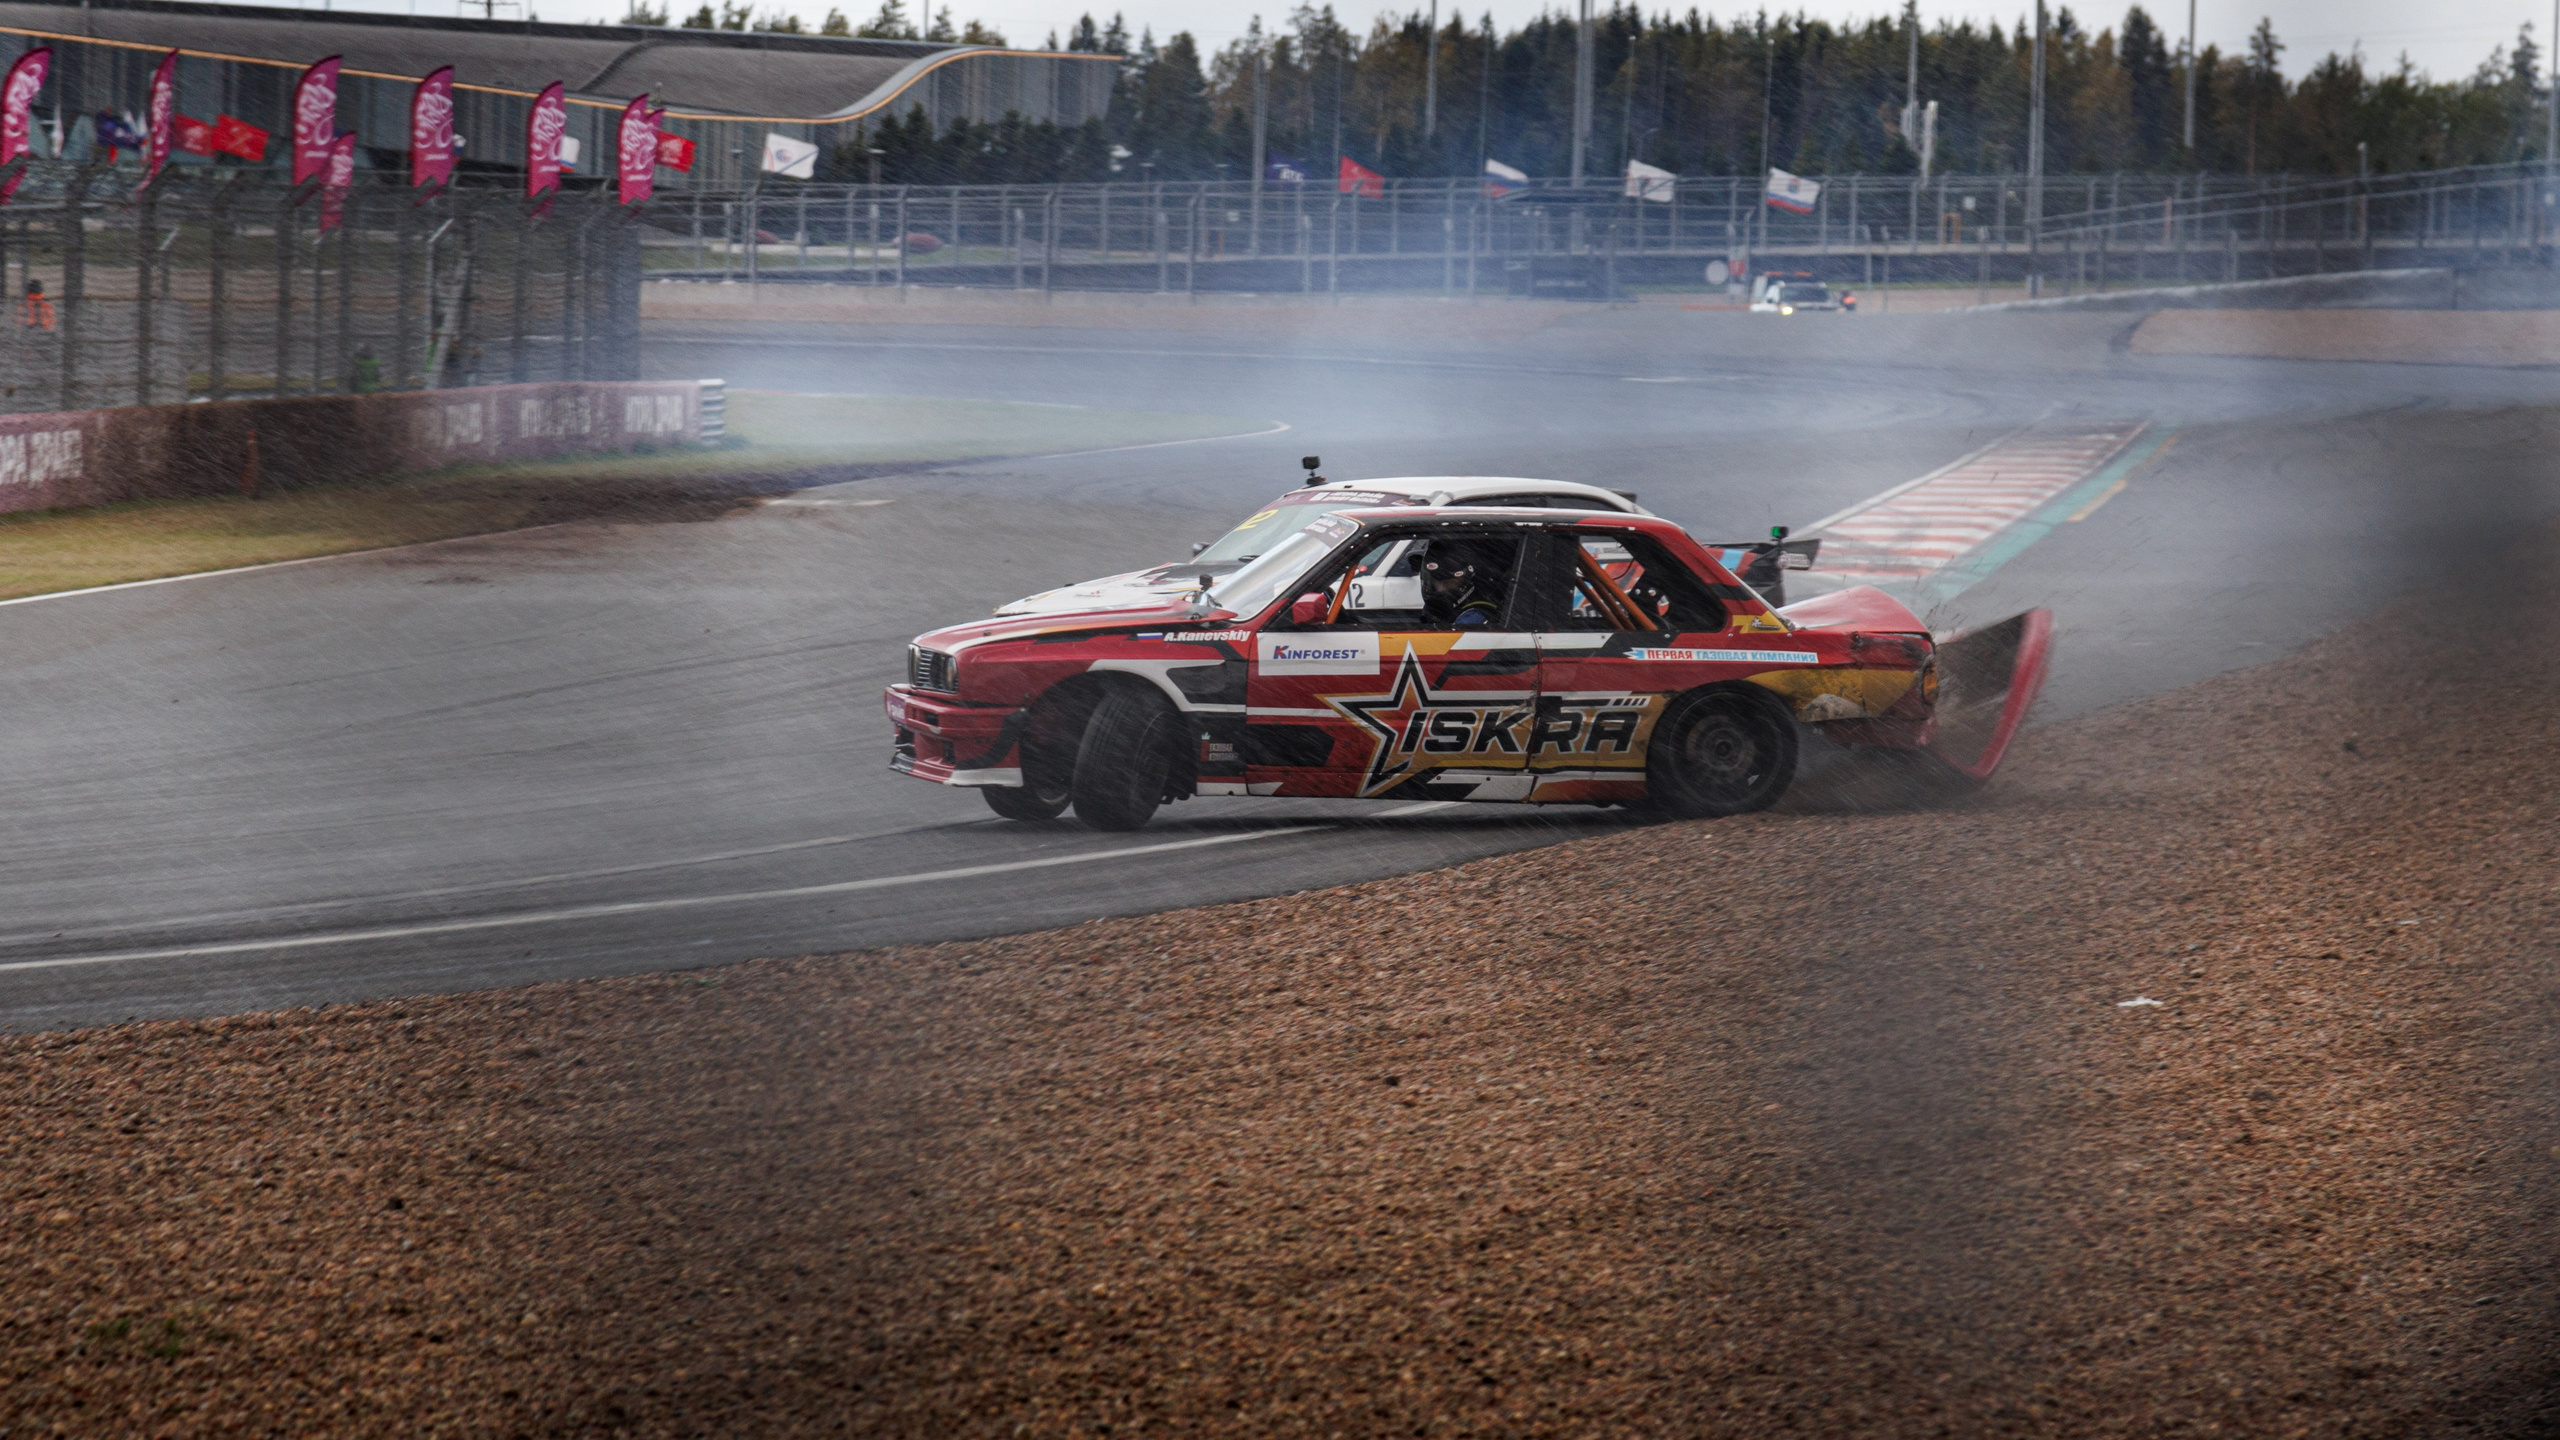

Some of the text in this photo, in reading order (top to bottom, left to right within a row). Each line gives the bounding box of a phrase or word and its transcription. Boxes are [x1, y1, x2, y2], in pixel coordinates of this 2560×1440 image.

[1164, 630, 1251, 642] A.Kanevskiy
[1273, 645, 1359, 660] KINFOREST
[1647, 649, 1817, 662] ПЕРВАЯ ГАЗОВАЯ КОМПАНИЯ
[1397, 709, 1642, 755] ISKRA
